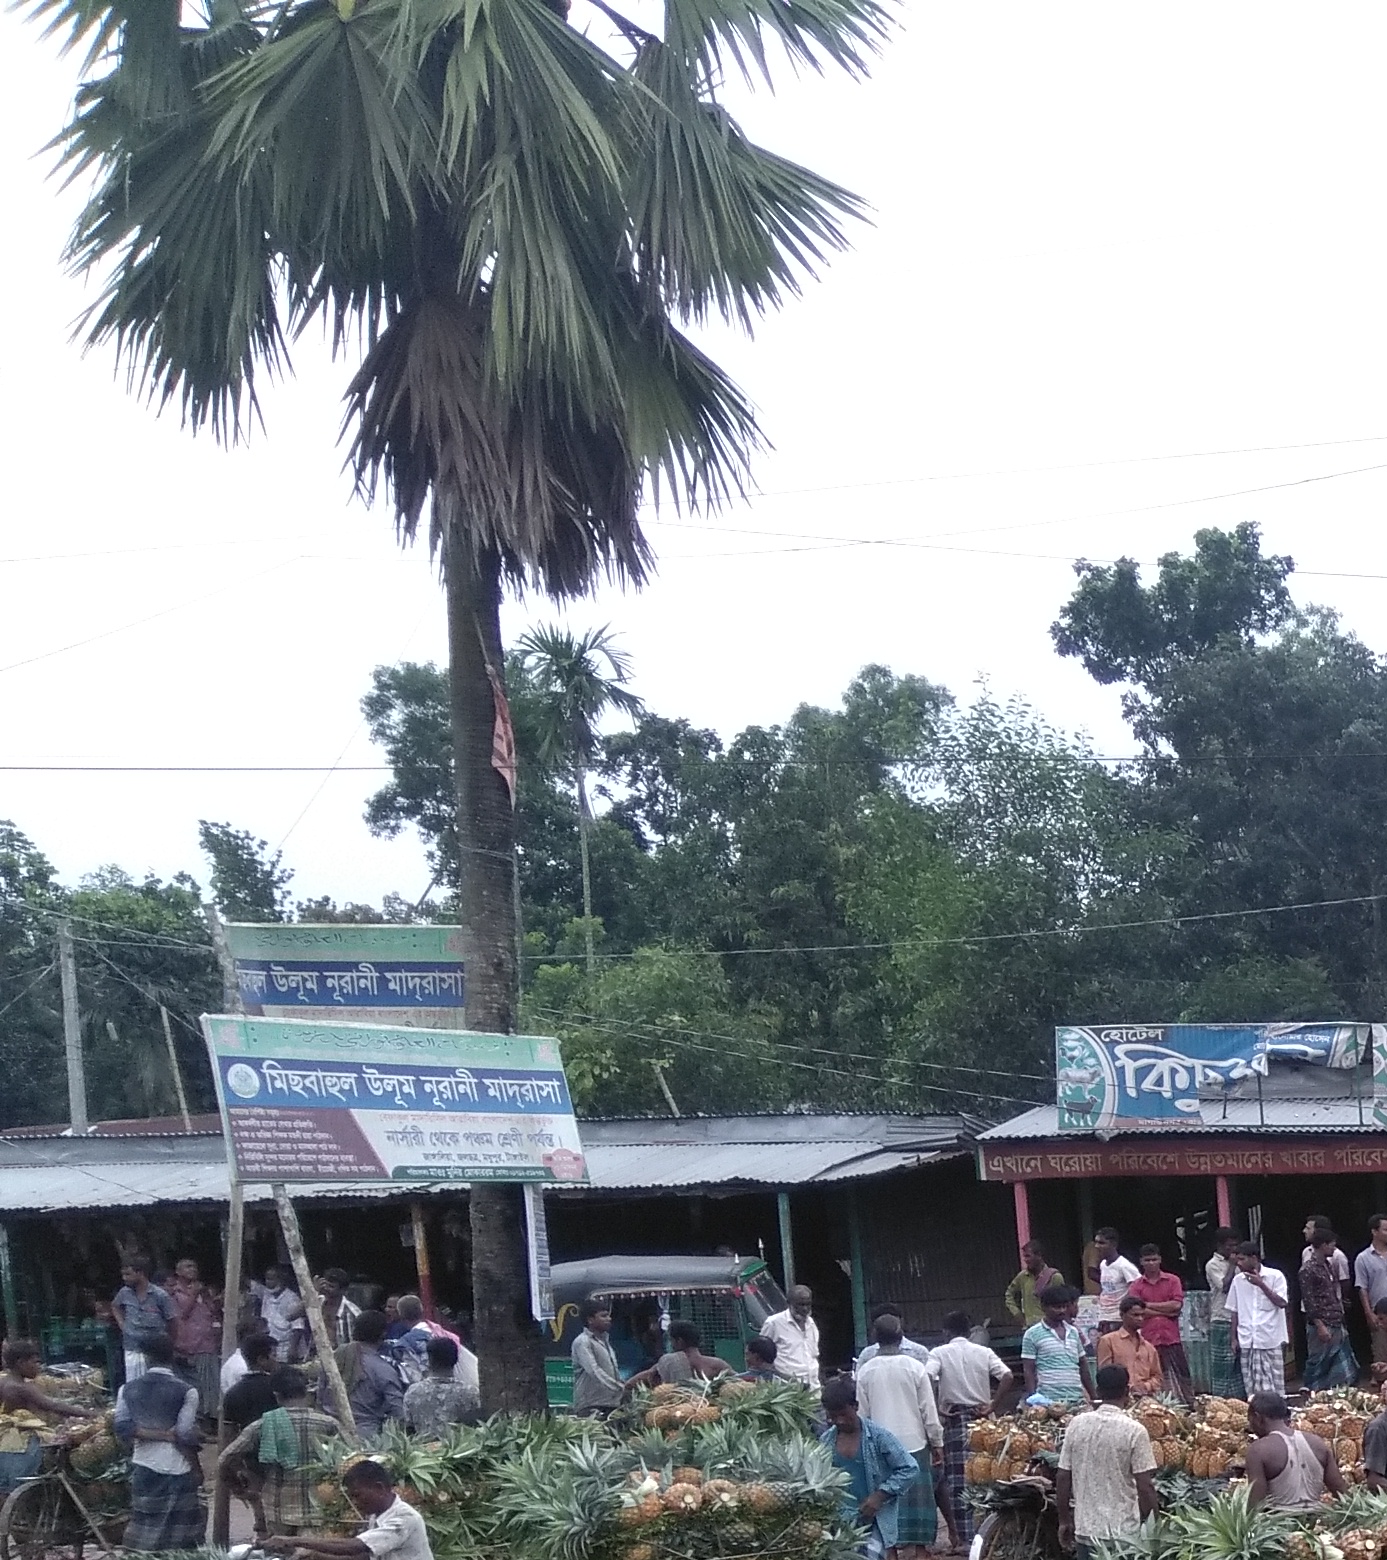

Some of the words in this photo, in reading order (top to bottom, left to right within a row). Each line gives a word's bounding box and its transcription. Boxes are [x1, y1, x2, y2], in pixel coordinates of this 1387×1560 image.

[1100, 1026, 1164, 1043] হোটেল
[420, 1068, 478, 1108] নূরানী
[429, 1131, 459, 1147] থেকে
[989, 1153, 1043, 1174] এখানে
[1047, 1153, 1102, 1172] ঘরোয়া
[1109, 1147, 1179, 1171] পরিবেশে
[1185, 1147, 1274, 1174] উন্নতমানের
[1280, 1150, 1325, 1169] খাবার
